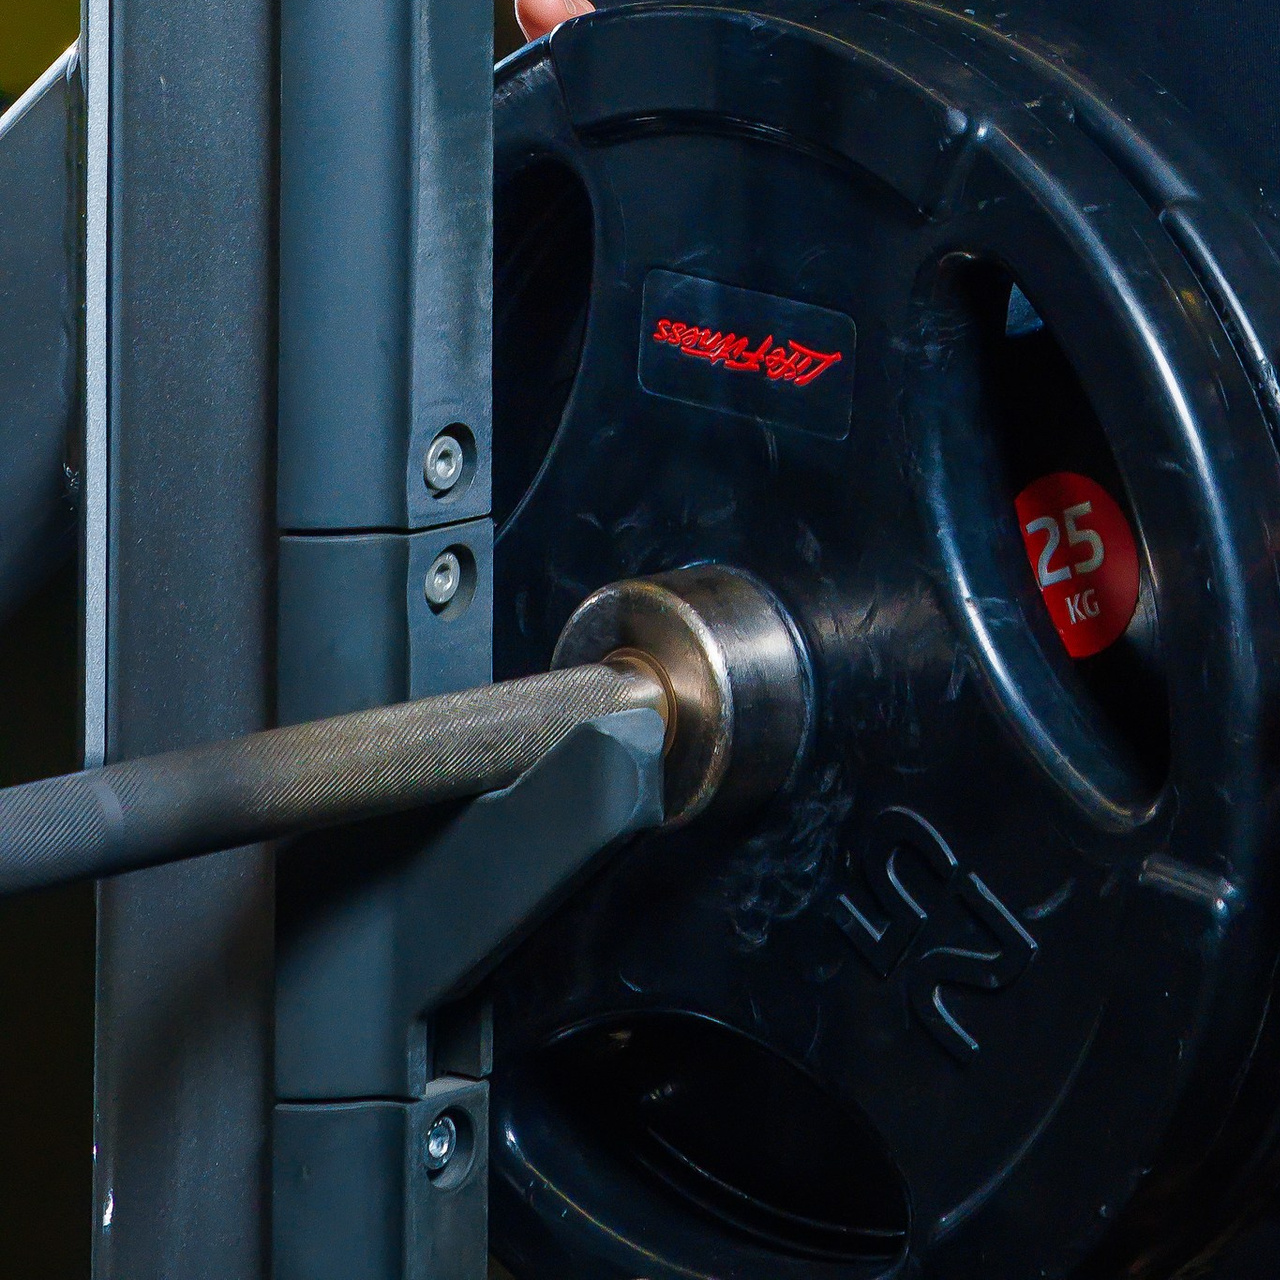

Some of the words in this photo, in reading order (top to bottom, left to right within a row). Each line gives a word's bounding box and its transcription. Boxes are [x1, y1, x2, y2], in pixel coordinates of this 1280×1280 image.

[1025, 500, 1105, 588] 25
[1064, 588, 1101, 626] KG
[826, 804, 1040, 1068] 25
